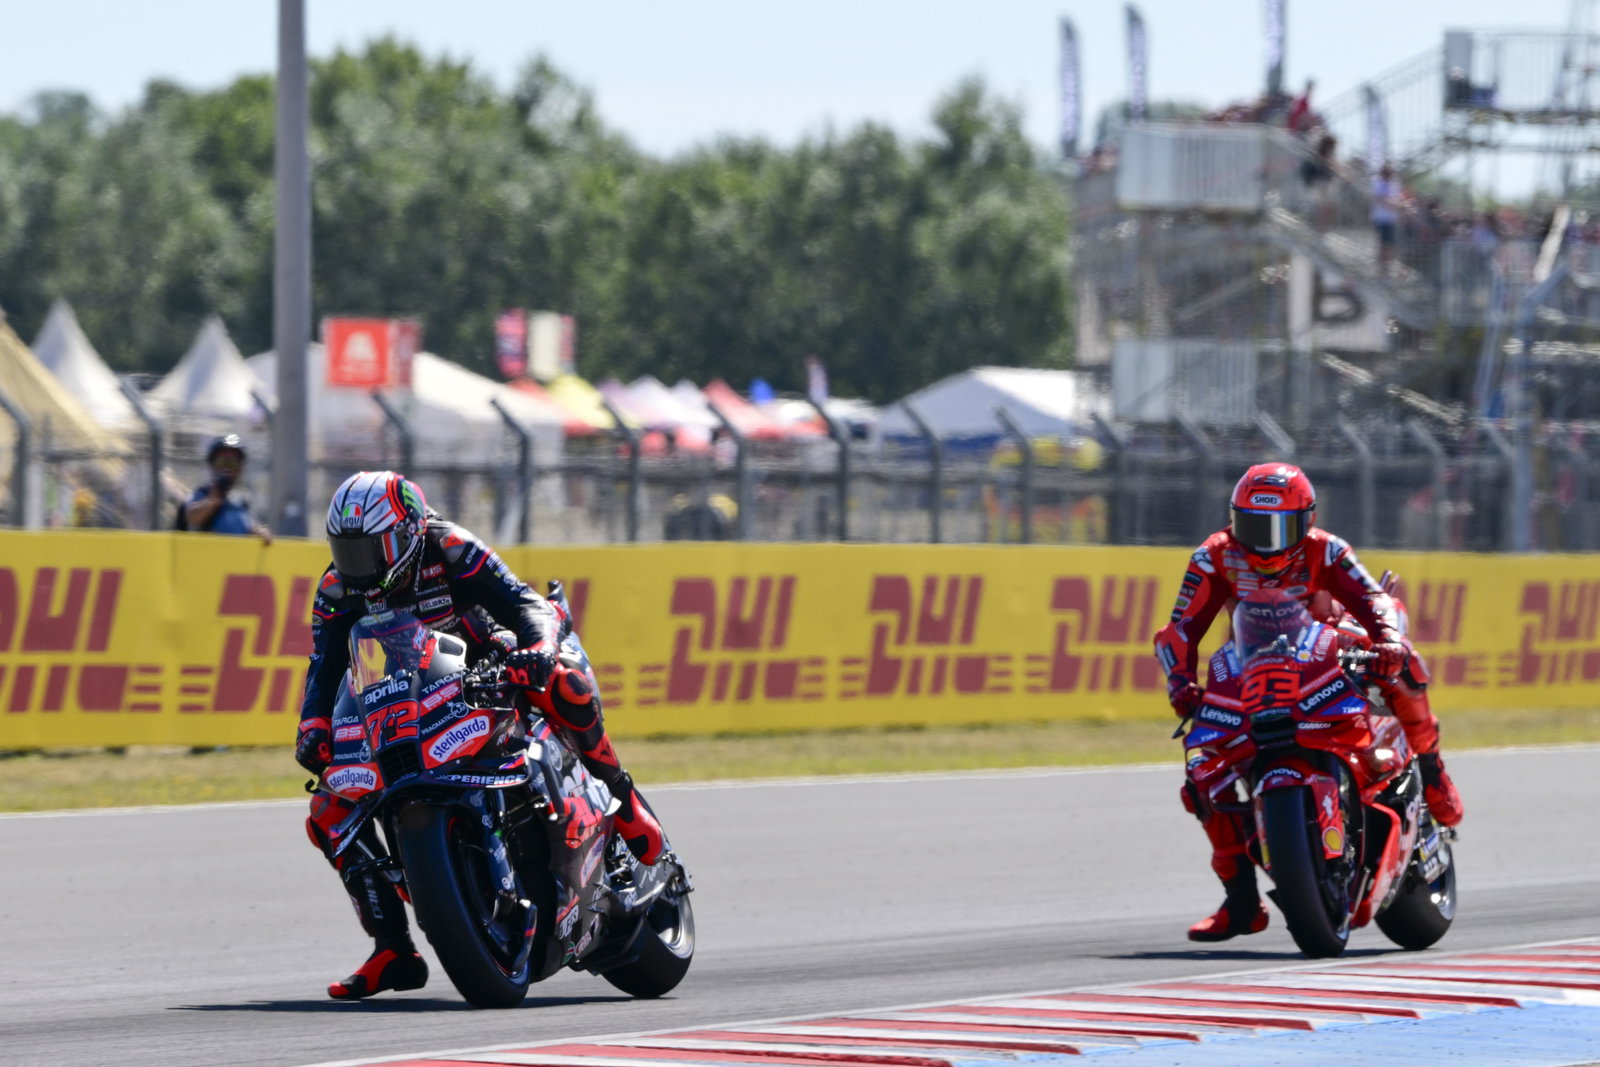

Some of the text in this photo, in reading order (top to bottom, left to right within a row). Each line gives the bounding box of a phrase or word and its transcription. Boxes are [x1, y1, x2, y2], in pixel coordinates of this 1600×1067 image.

[1254, 496, 1278, 504] SHOEI
[666, 573, 798, 703] DHL
[864, 574, 989, 697] DHL
[1047, 575, 1160, 694] DHL
[365, 680, 409, 705] aprilia
[422, 684, 460, 706] BS
[1299, 681, 1344, 712] Lenovo
[365, 699, 420, 751] 72
[1201, 705, 1242, 726] Lenovo
[335, 726, 362, 739] BS
[433, 719, 487, 759] sterilgarda
[329, 769, 374, 788] sterilgarda
